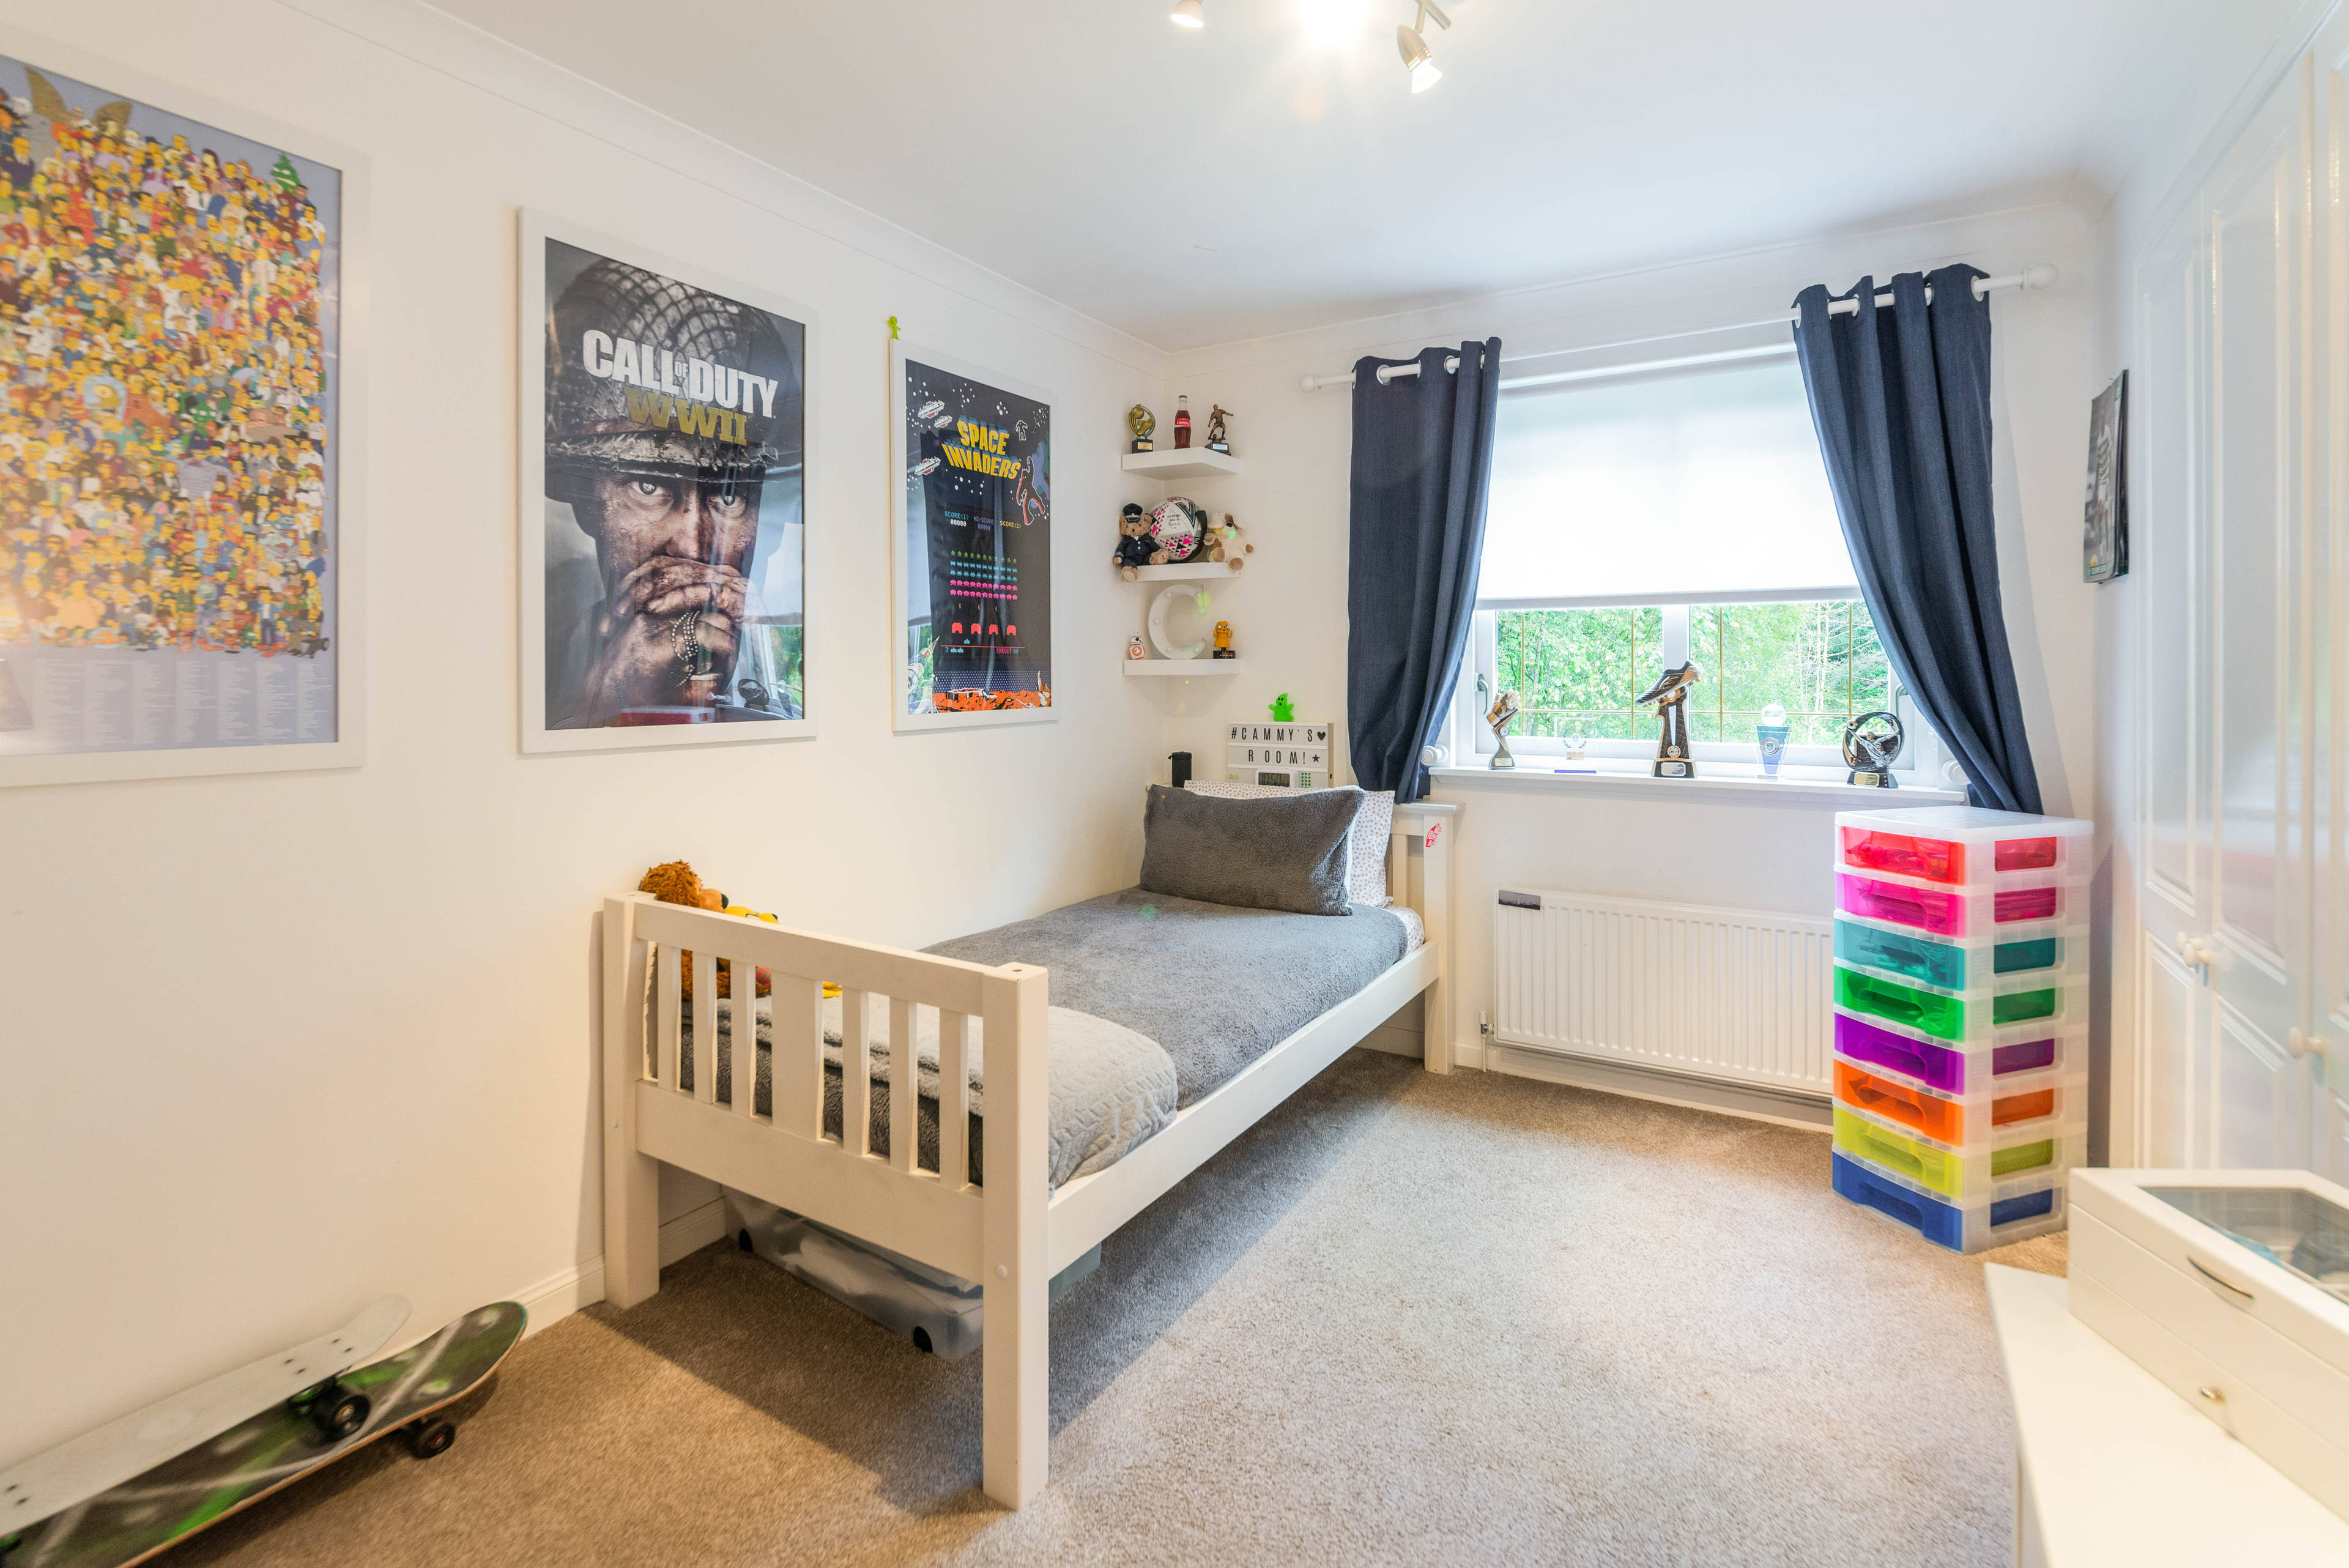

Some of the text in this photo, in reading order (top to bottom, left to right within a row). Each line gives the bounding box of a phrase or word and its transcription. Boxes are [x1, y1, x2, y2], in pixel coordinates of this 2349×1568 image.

[583, 329, 778, 418] CALL OF DUTY
[624, 386, 747, 446] WWII
[957, 420, 1010, 455] SPACE
[941, 444, 1022, 479] INVADERS
[944, 510, 1022, 529] SCORE<1> HI-SCORE SCORE<2>
[1231, 727, 1313, 742] #CAMMY'S
[1248, 749, 1305, 764] ROOM!
